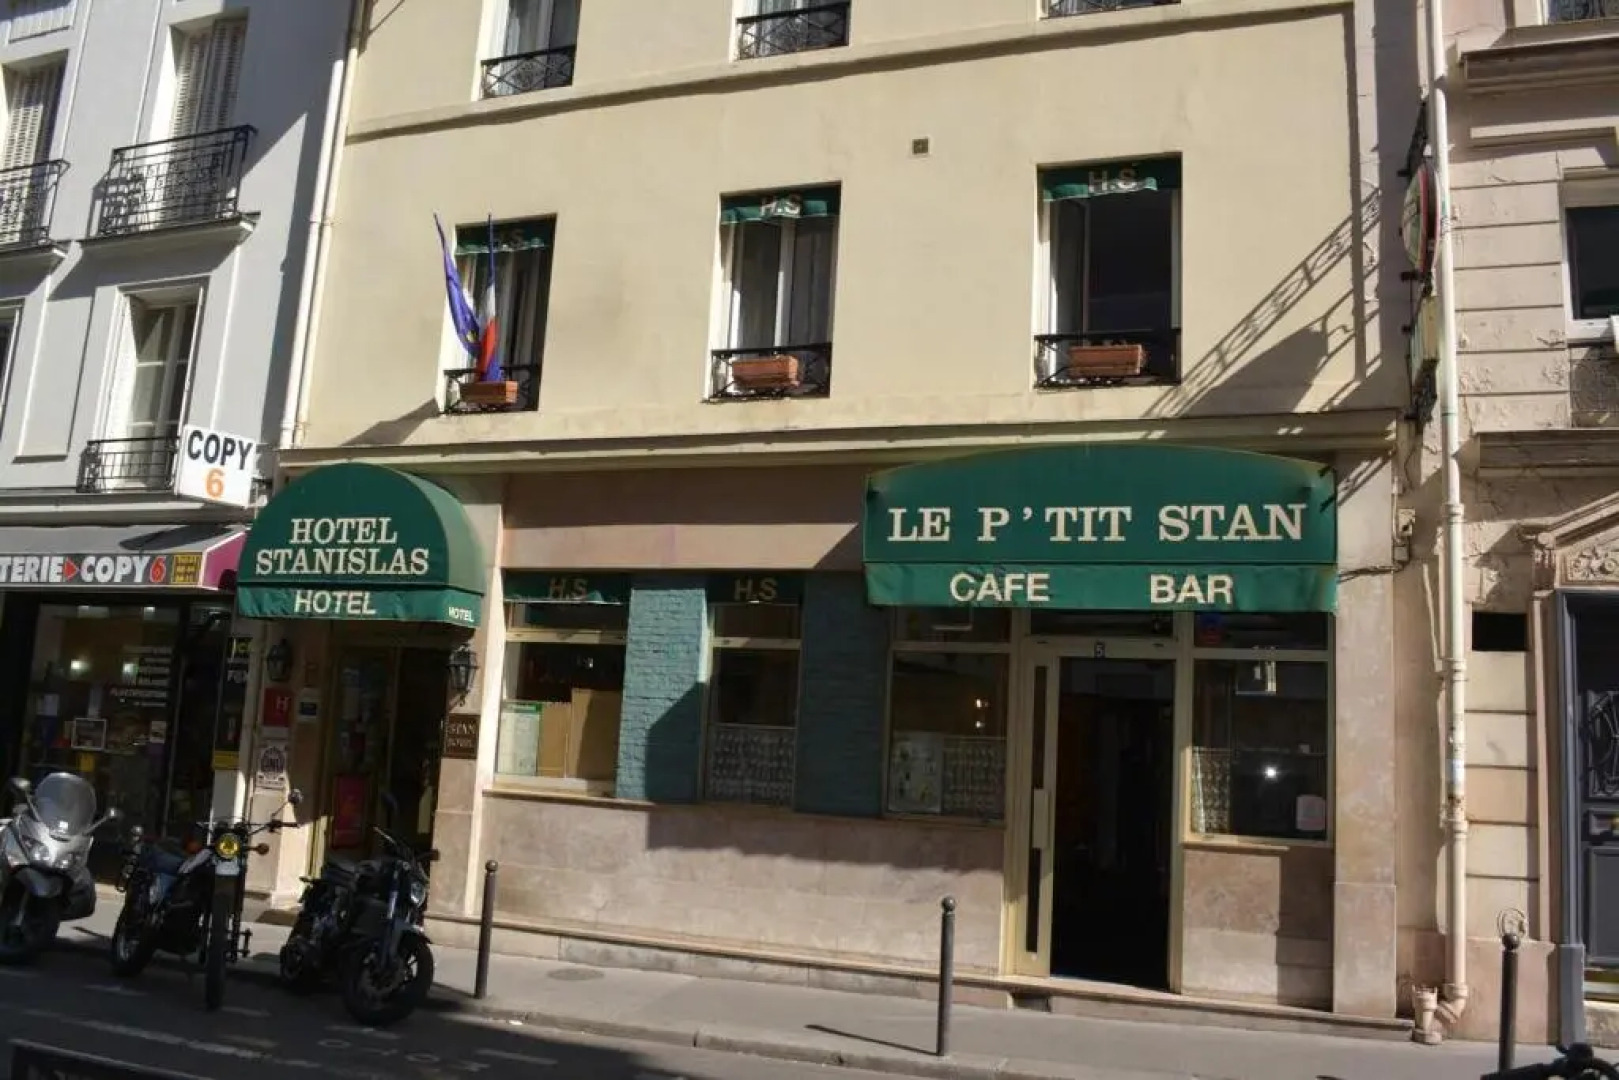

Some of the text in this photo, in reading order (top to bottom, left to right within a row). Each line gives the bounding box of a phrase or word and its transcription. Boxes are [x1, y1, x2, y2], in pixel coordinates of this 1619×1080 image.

[187, 430, 253, 470] COPY
[206, 468, 225, 498] 6
[289, 517, 398, 545] HOTEL
[887, 507, 951, 542] LE
[1158, 503, 1307, 542] STAN
[255, 548, 429, 575] STANISLAS
[293, 590, 377, 615] HOTEL
[950, 573, 1234, 604] CAFE BAR
[448, 606, 475, 623] HOTEL
